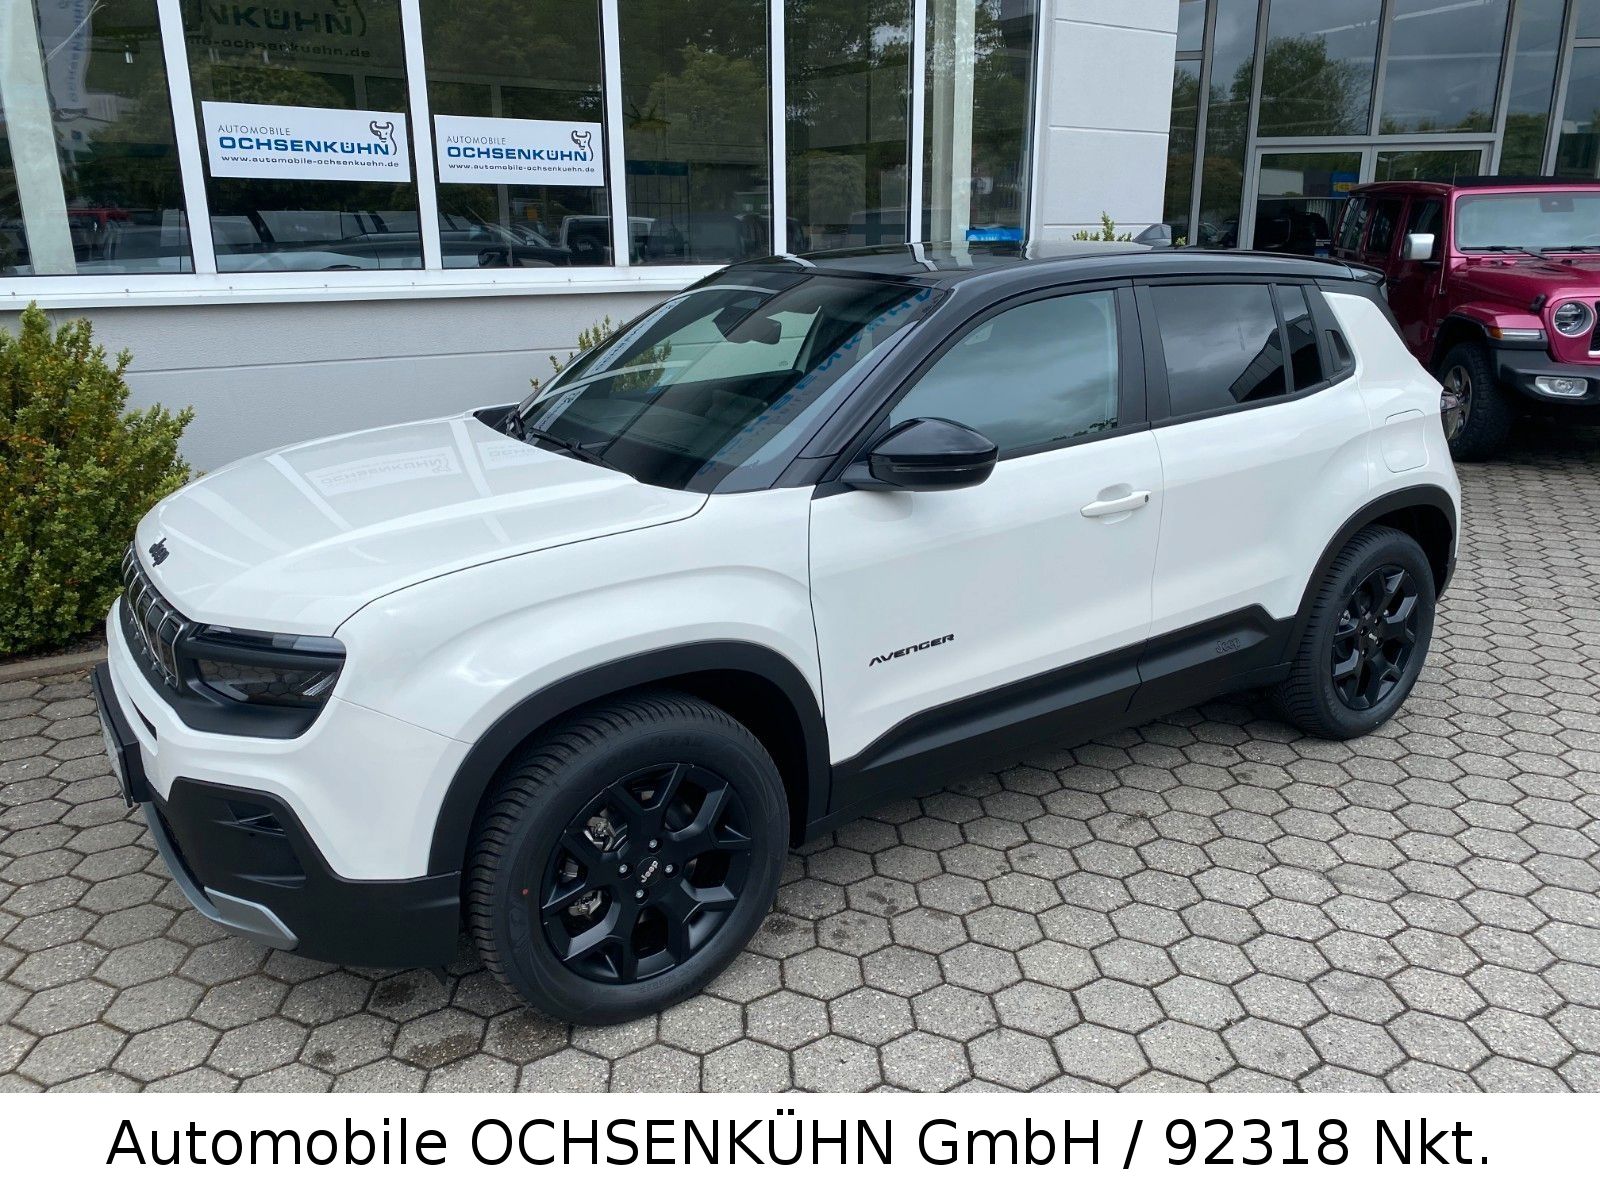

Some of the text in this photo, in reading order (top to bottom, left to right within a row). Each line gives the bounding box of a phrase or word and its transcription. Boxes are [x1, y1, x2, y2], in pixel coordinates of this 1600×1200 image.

[217, 124, 291, 136] AUTOMOBILE
[219, 136, 390, 156] OCHSENKÜHN
[446, 135, 506, 146] AUTOMOBILE
[221, 155, 400, 168] www.automobile-ochsenkuehn.de
[447, 146, 587, 162] OCHSENKÜHN
[448, 163, 595, 173] www.automobile-ochsenkuehn.de
[868, 633, 955, 667] AVENGER
[1215, 638, 1240, 653] Jeep
[640, 860, 659, 883] Jeep
